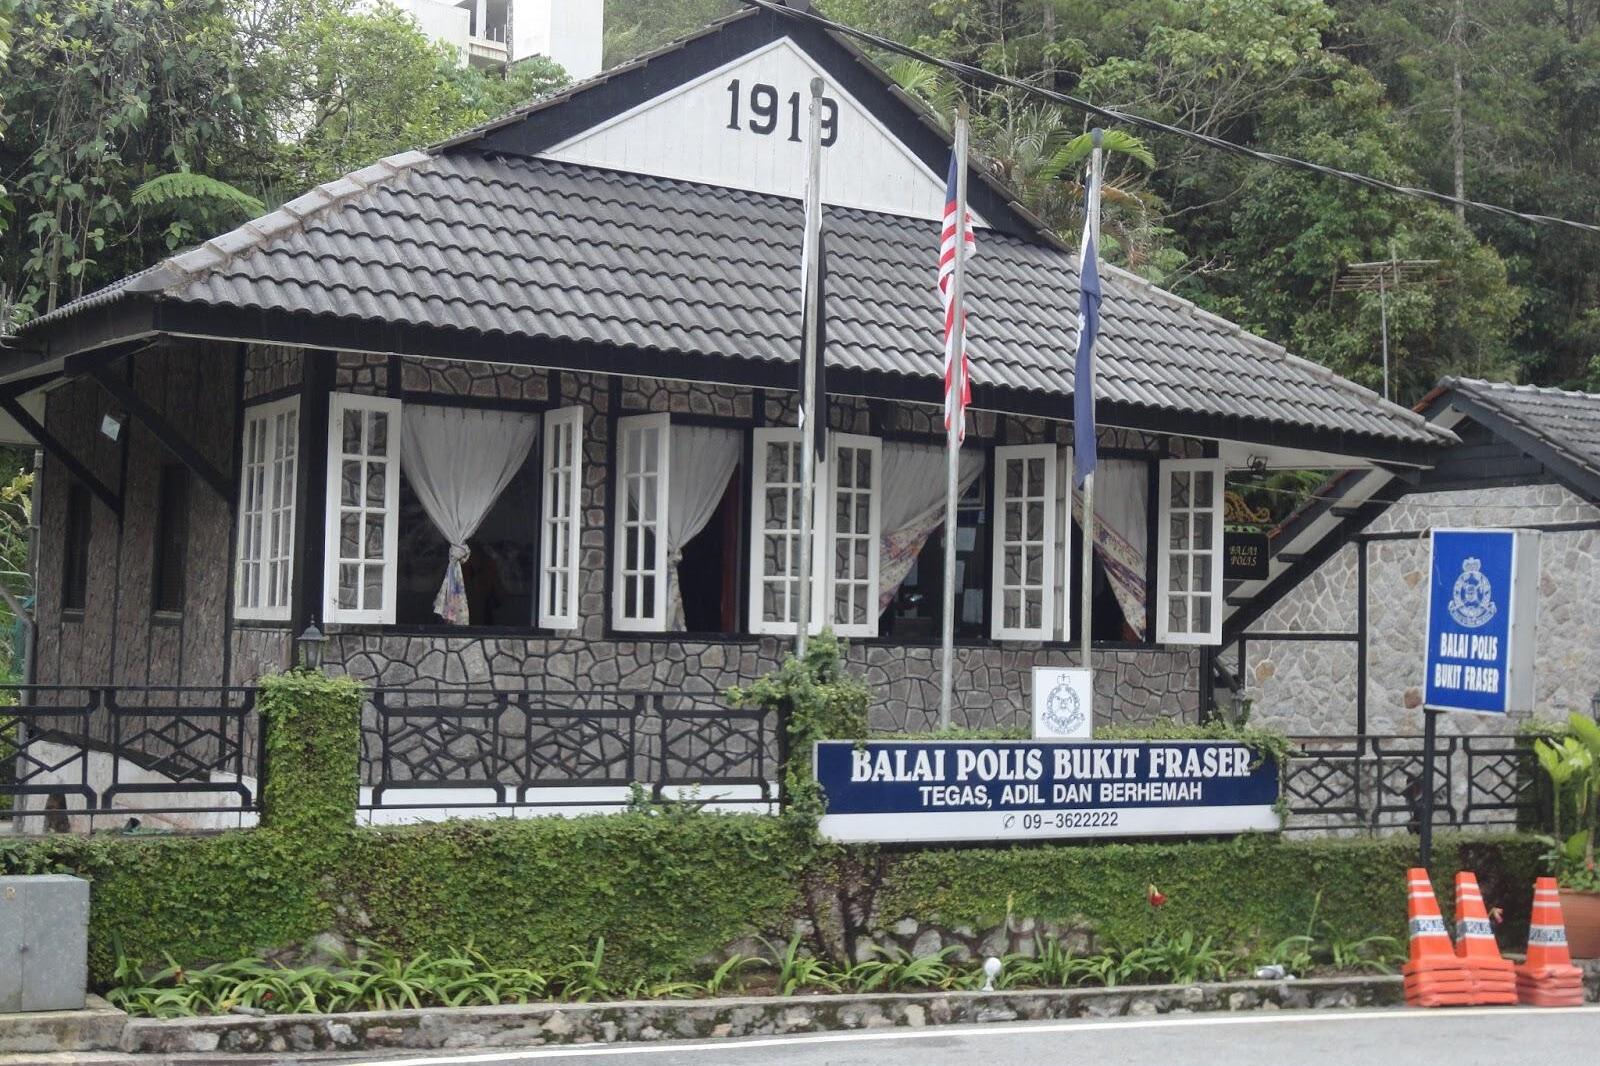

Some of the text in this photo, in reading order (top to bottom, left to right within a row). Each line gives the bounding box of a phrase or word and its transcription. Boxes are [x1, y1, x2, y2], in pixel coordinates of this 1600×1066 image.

[726, 79, 838, 148] 1919
[1440, 632, 1498, 661] BALAI POLIS
[1434, 663, 1499, 693] BUKIT FRASER
[851, 747, 1251, 782] BALAI POLIS BUKIT FRASER
[918, 781, 1203, 809] TEGAS, ADIL DAN BERHEMAH
[1023, 811, 1119, 830] 09-3622222
